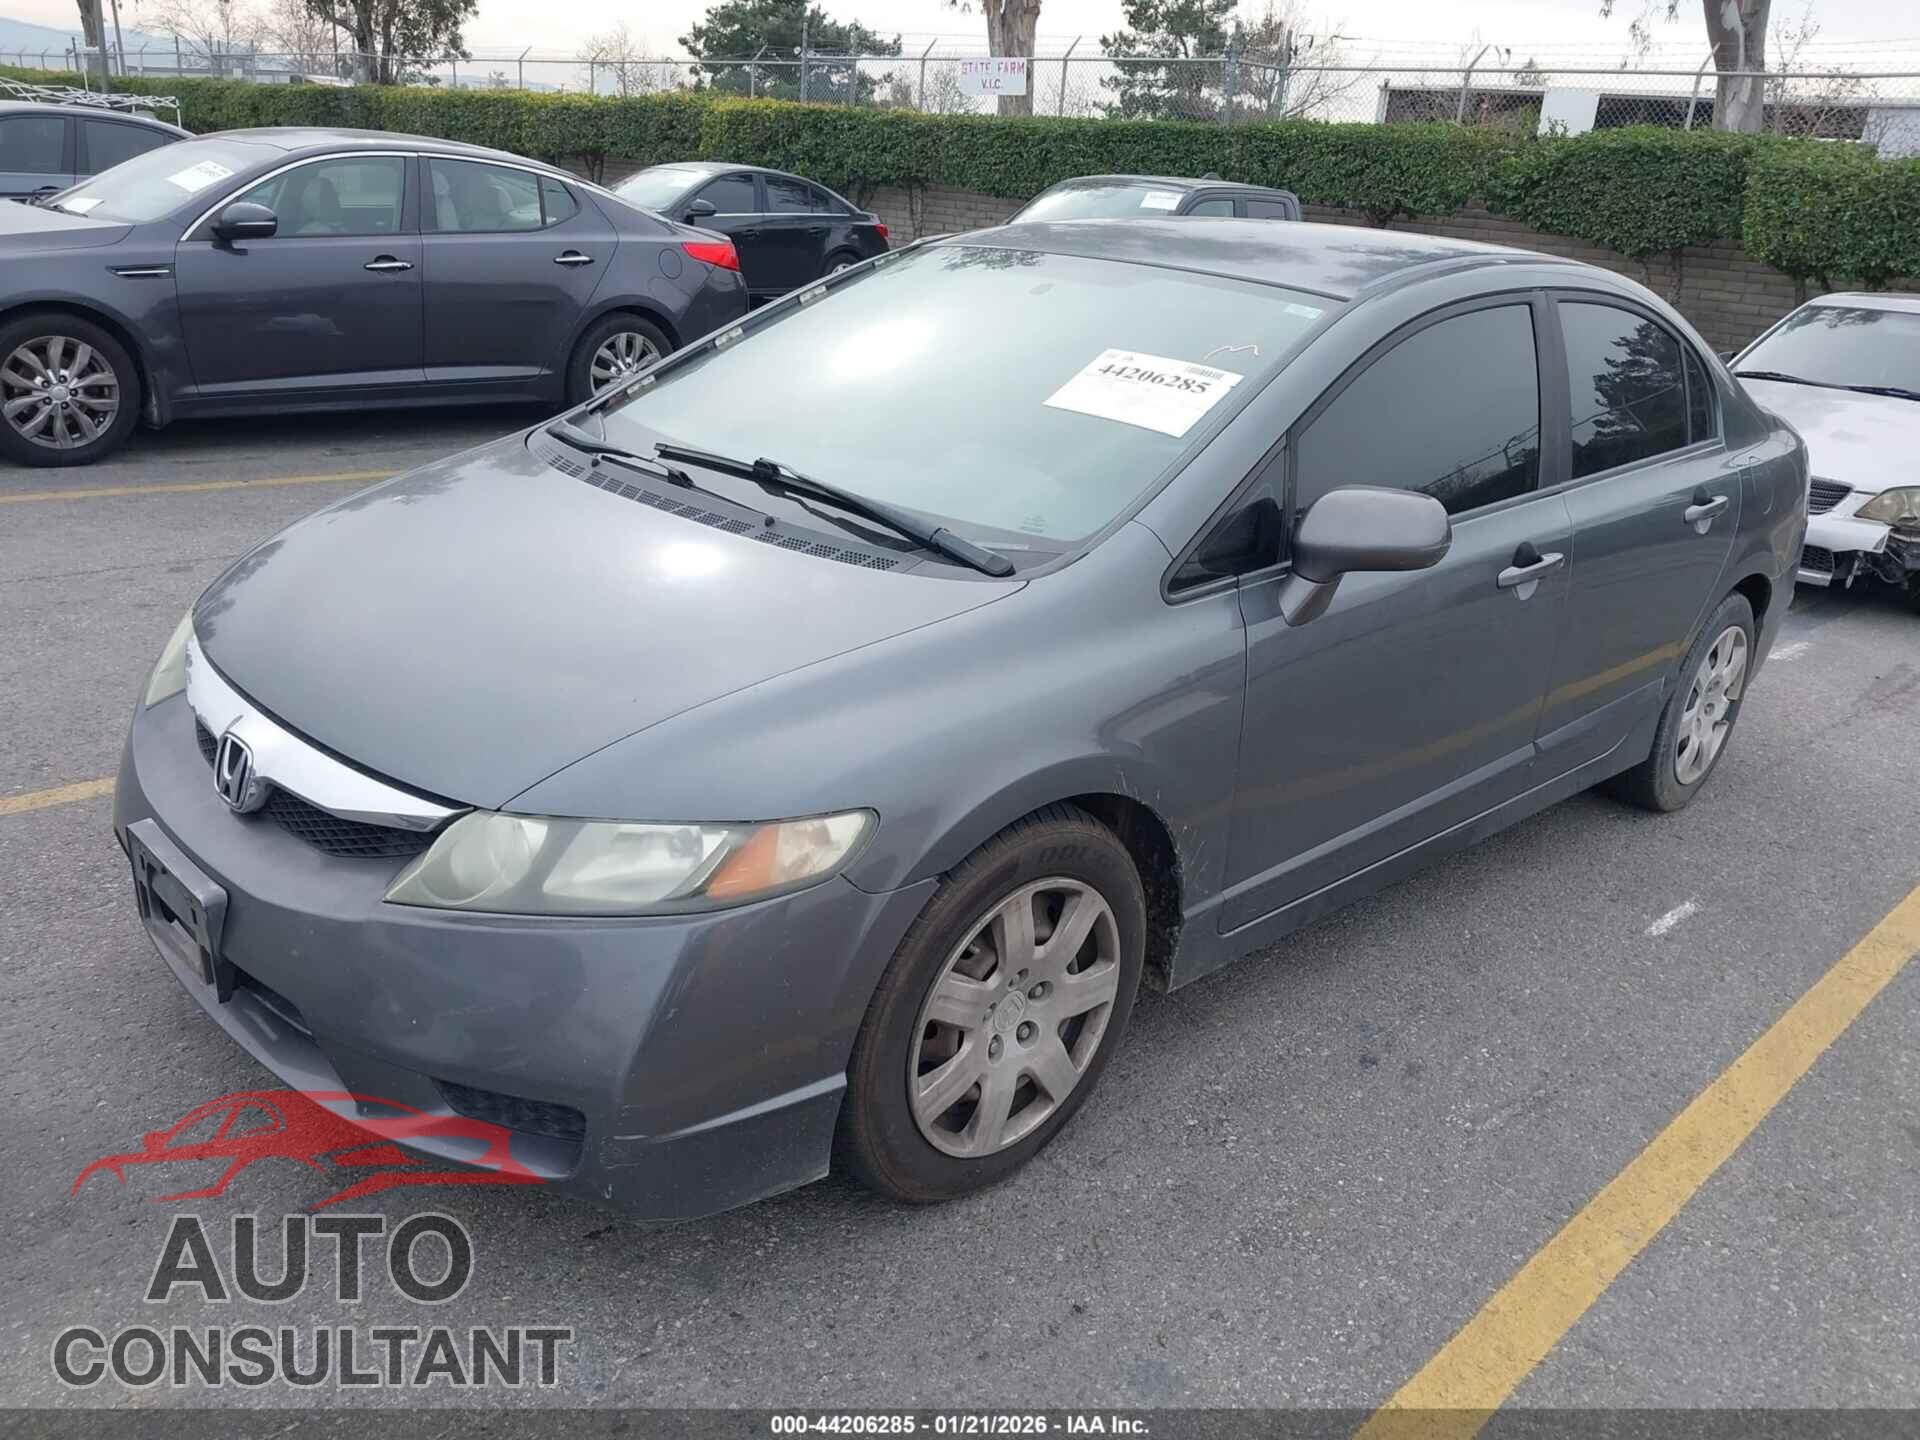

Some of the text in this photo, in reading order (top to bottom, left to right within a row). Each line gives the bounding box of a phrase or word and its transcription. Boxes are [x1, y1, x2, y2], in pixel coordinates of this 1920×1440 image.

[961, 62, 1025, 74] STATE FARM
[1098, 363, 1212, 394] 44206285
